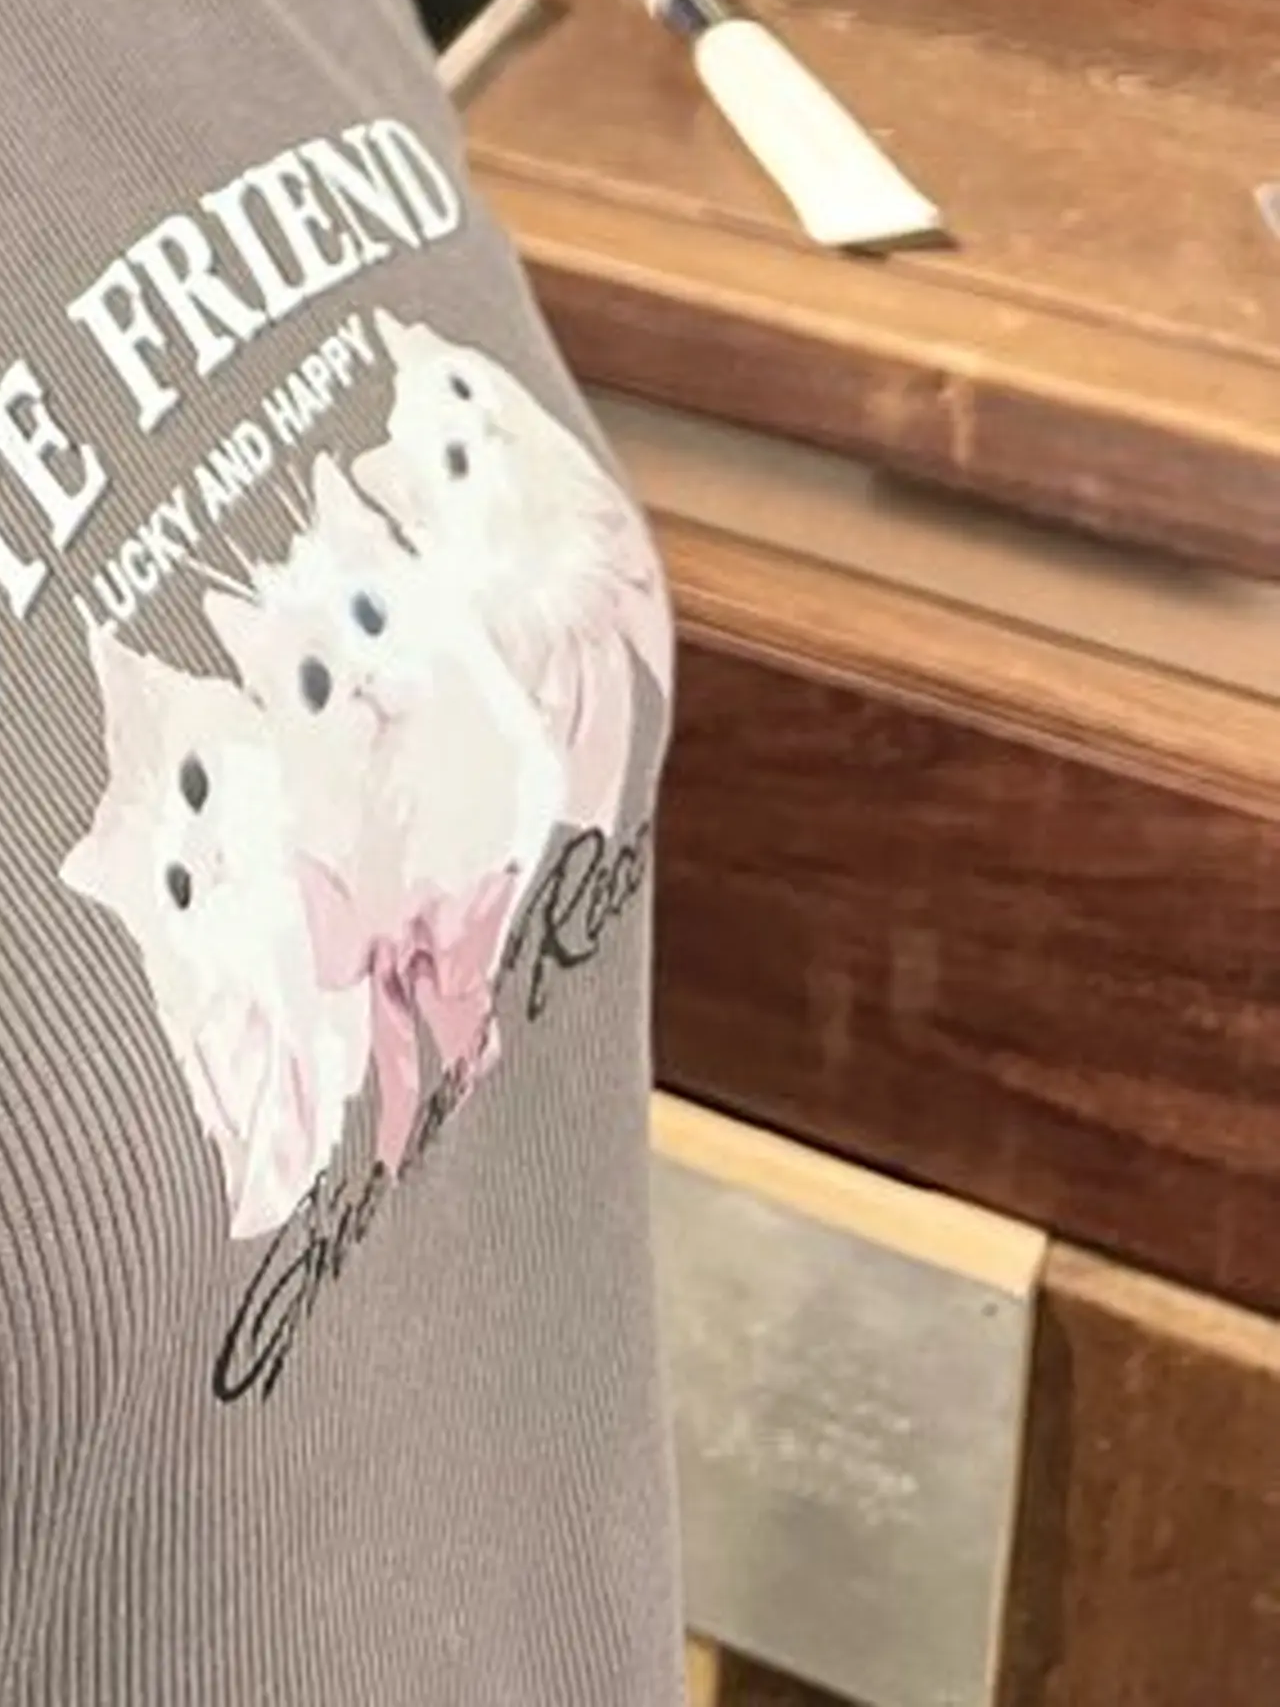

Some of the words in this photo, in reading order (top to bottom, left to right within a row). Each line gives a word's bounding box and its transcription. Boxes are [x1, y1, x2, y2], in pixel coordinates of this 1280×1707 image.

[67, 116, 462, 433] FRIEND
[192, 420, 274, 525] AND
[261, 313, 376, 446] HAPPY
